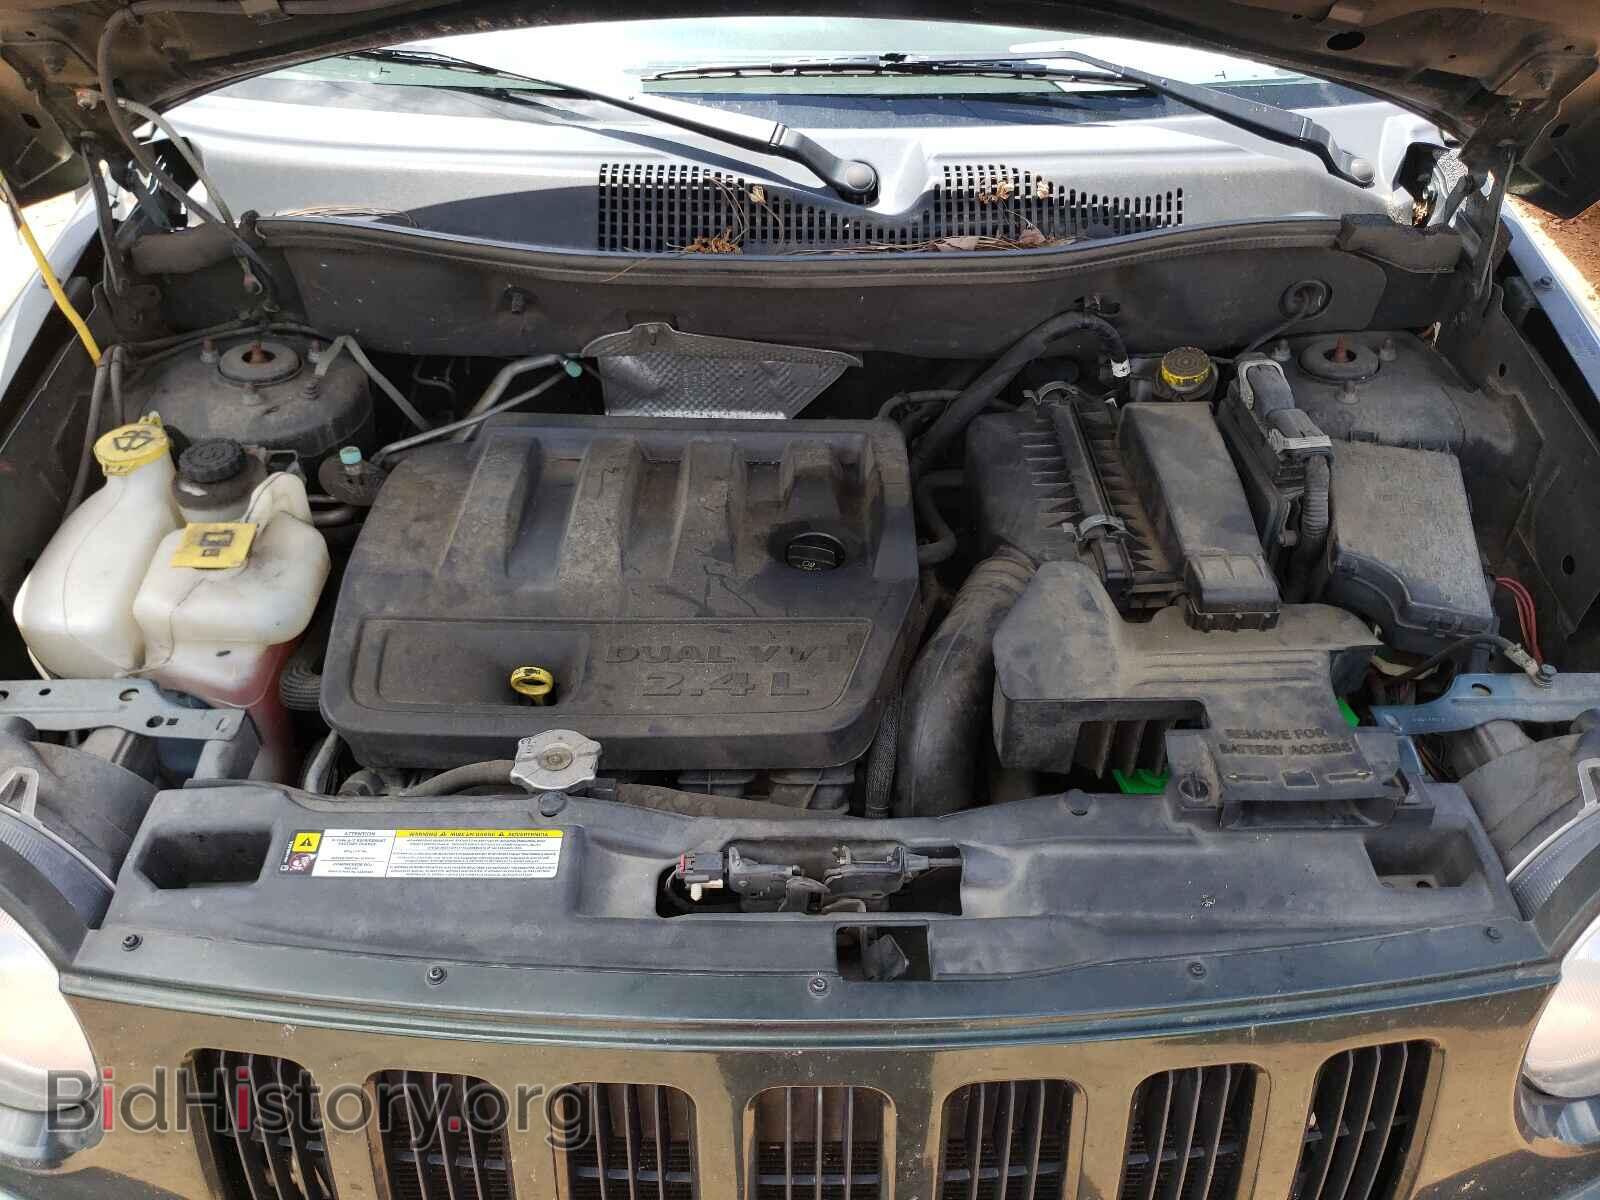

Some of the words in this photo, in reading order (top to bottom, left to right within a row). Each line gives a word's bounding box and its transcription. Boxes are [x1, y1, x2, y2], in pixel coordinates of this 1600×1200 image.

[605, 643, 737, 664] DUAL
[746, 643, 850, 664] VVT
[641, 671, 810, 697] 2.4L
[1224, 728, 1291, 740] REMOVE
[1294, 727, 1329, 739] FOR
[1219, 743, 1283, 755] BATTERY
[1288, 741, 1352, 755] ACCESS
